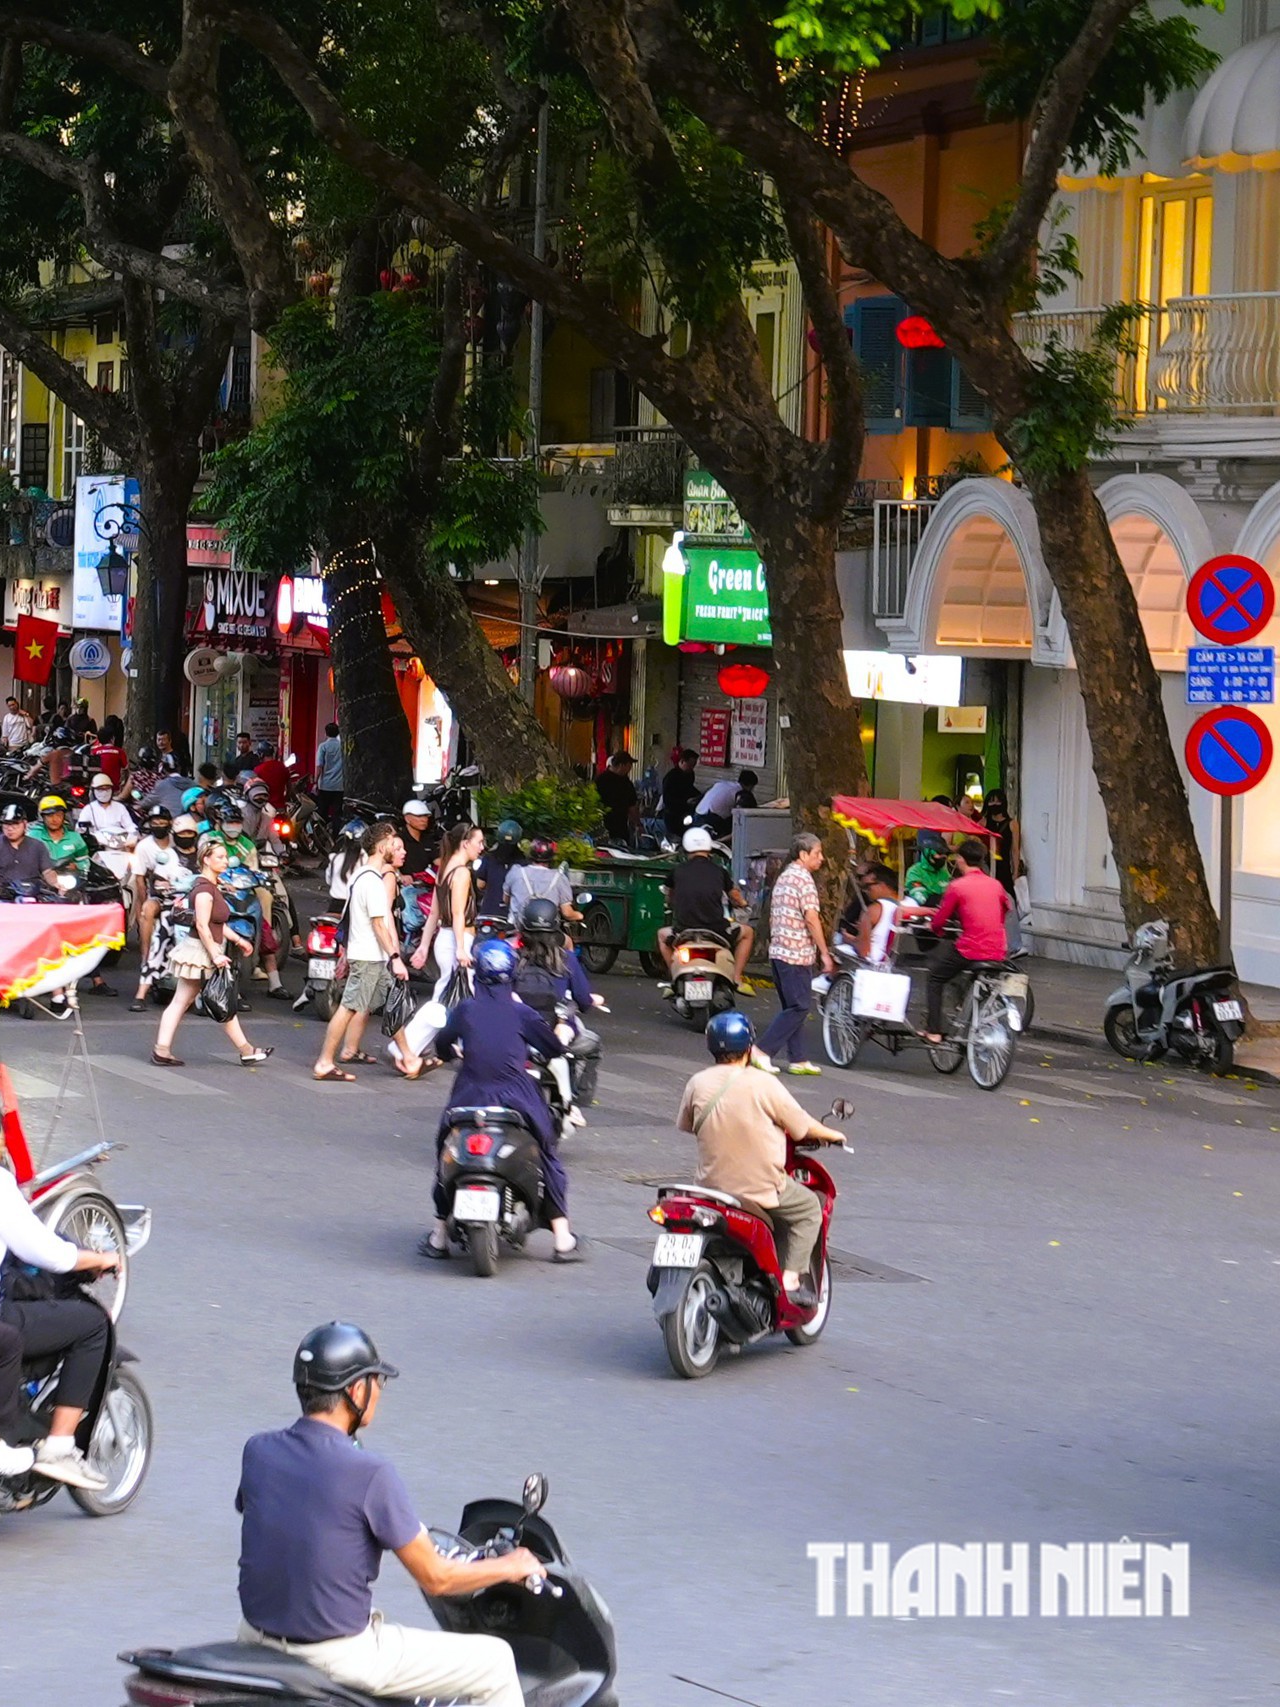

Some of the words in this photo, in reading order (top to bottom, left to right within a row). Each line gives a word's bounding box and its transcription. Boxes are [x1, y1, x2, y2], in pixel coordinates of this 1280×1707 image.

[217, 571, 266, 618] MIXUE
[708, 560, 752, 595] Green
[1216, 651, 1227, 663] XE
